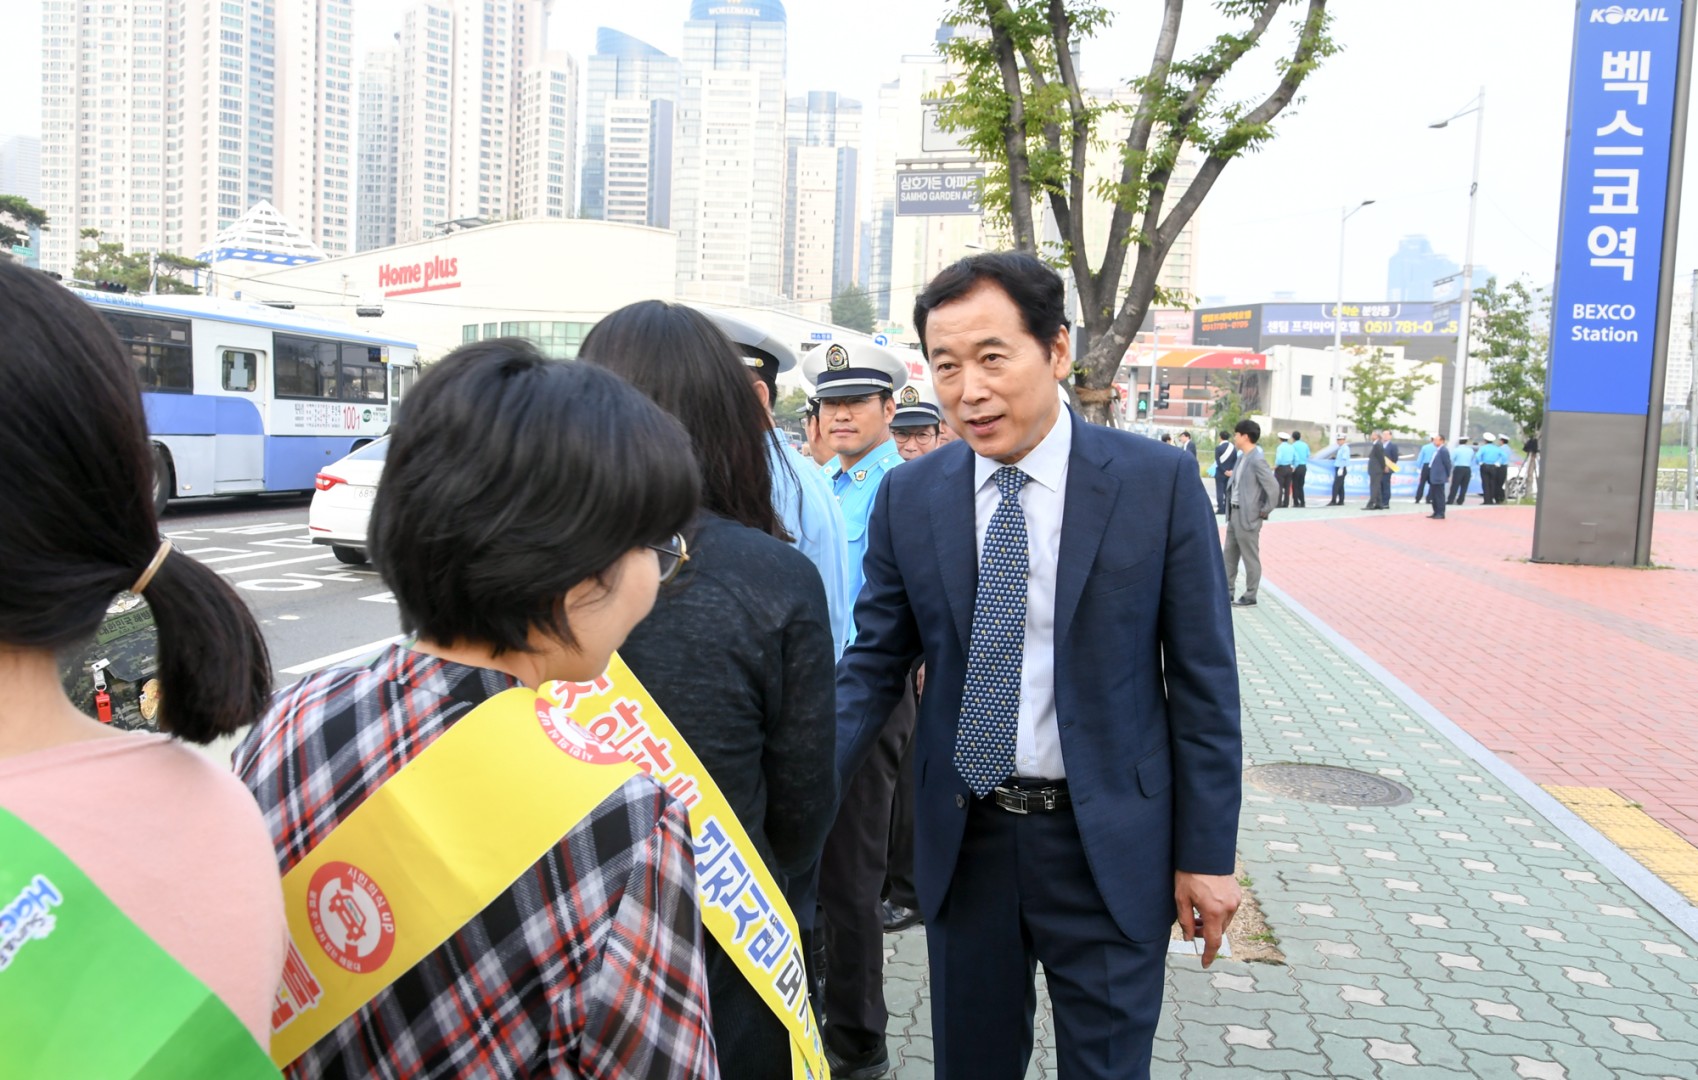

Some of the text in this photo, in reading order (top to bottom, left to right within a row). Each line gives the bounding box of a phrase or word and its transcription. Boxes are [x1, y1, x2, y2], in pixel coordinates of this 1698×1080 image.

[1589, 5, 1669, 24] KORAIL
[1587, 50, 1651, 281] 벡스코역
[901, 176, 942, 190] 삼호가든
[901, 190, 977, 201] SAMHO GARDEN AP
[378, 255, 458, 289] Home plus
[1572, 303, 1636, 320] BEXCO
[1395, 320, 1459, 334] 781-05
[1571, 325, 1639, 342] Station
[1232, 357, 1244, 365] SK
[694, 820, 790, 969] 선진시민
[381, 912, 395, 934] UP
